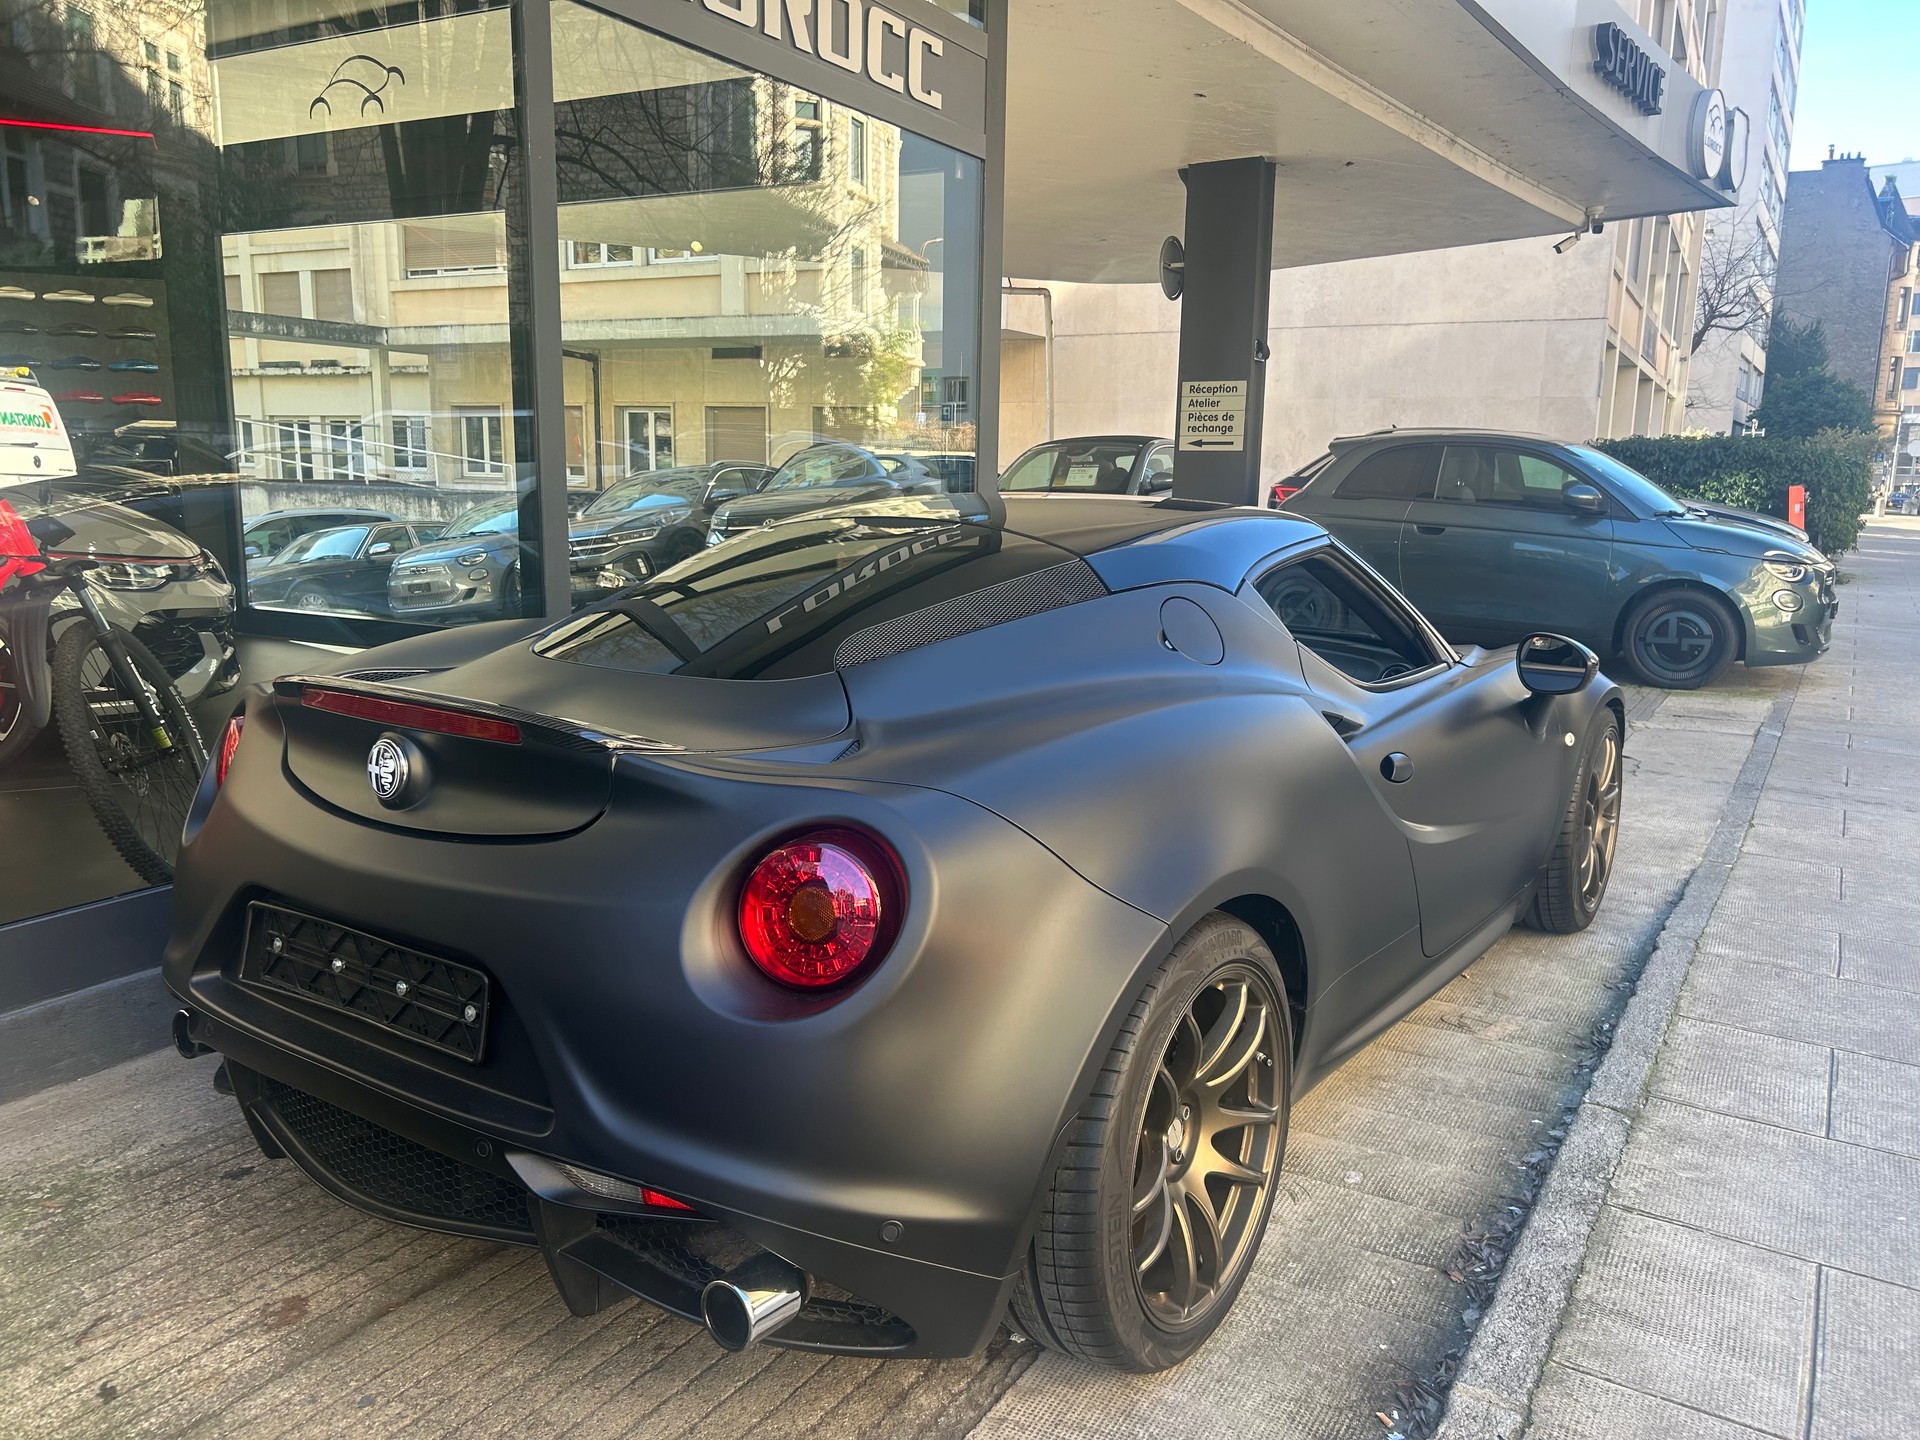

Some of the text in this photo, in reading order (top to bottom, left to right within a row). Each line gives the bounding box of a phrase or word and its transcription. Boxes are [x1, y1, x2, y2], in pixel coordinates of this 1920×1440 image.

[1595, 22, 1666, 116] SERVICE
[1189, 384, 1238, 395] Réception
[1188, 398, 1221, 408] Atelier
[1188, 412, 1235, 422] Pièces de
[1187, 423, 1234, 435] rechange
[168, 685, 210, 761] SCHWALB
